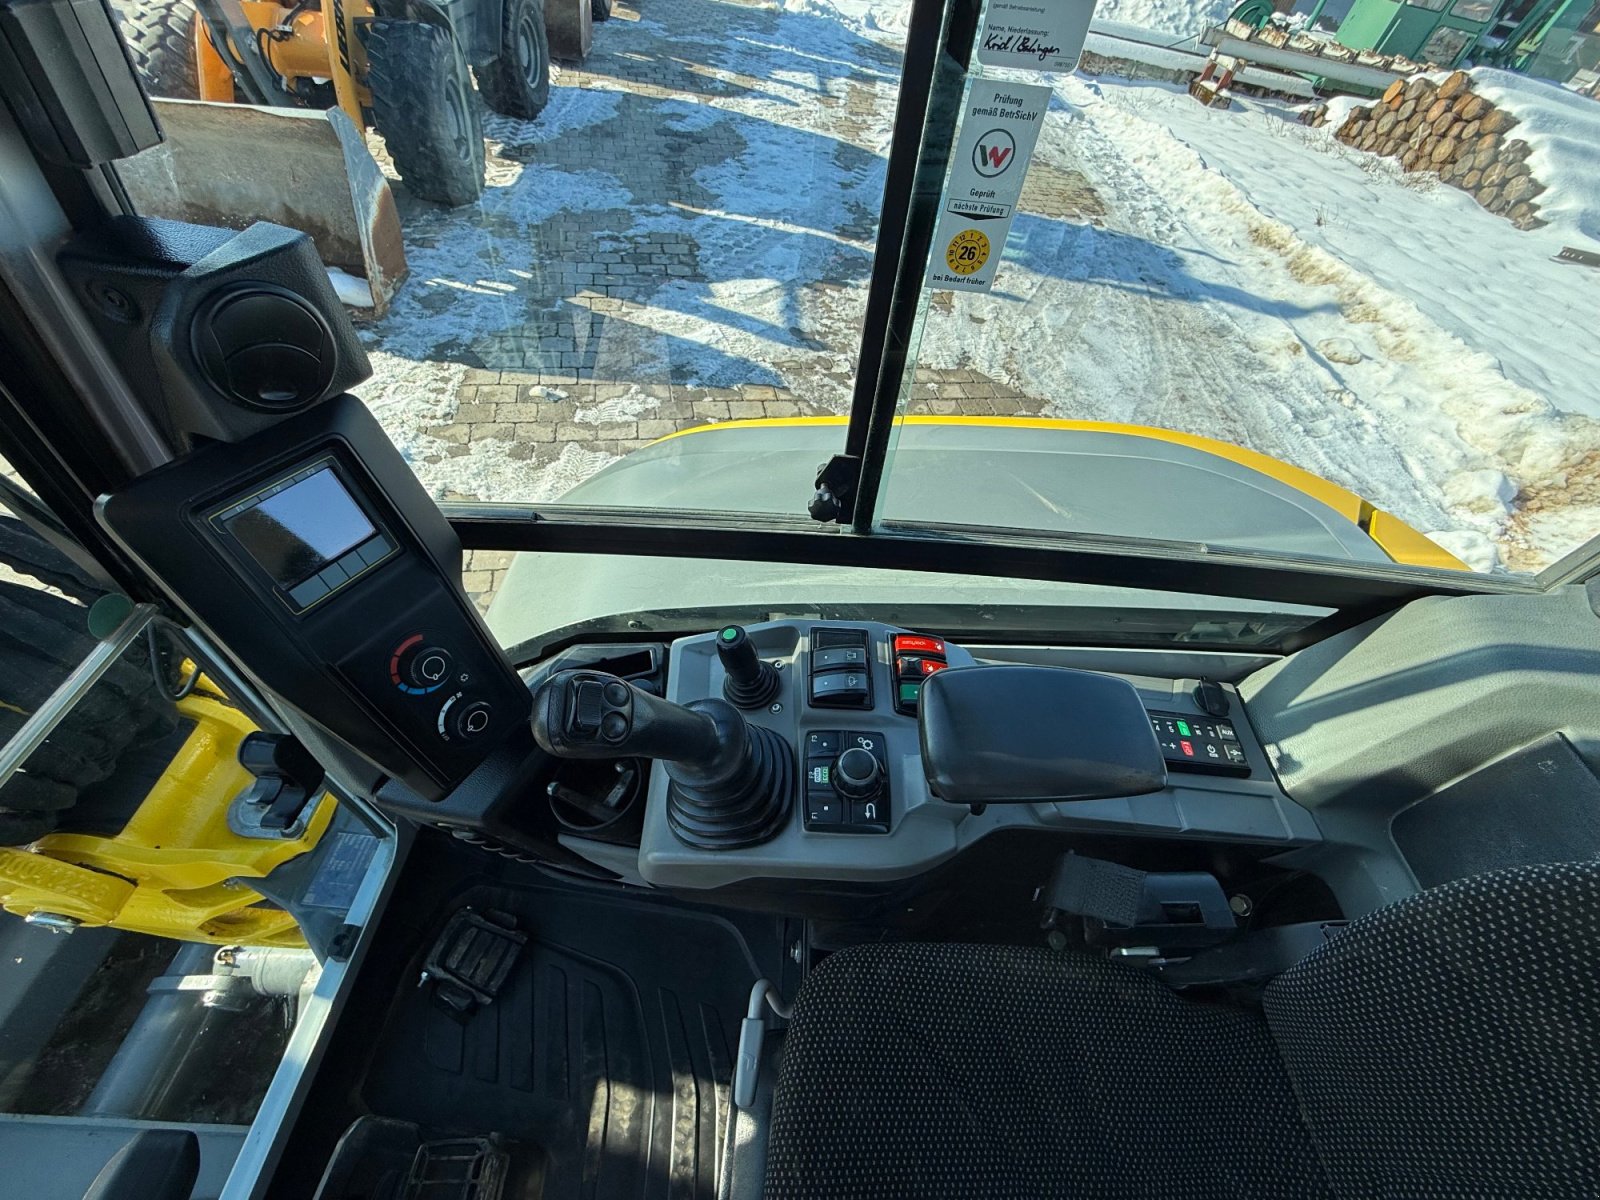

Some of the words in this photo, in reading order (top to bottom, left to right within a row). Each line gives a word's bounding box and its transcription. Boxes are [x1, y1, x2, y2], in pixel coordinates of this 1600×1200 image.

[988, 23, 1006, 33] Name,
[1008, 26, 1050, 38] Niederlassung:
[994, 93, 1024, 107] Prüfung
[971, 107, 998, 117] gemäß
[999, 108, 1038, 122] BetrSichV
[970, 188, 996, 199] Geprüft
[954, 202, 978, 212] nächste
[980, 204, 1004, 216] Prüfung
[958, 245, 977, 260] 26
[933, 273, 943, 281] bei
[944, 274, 966, 284] Bedarf
[966, 277, 986, 286] früher
